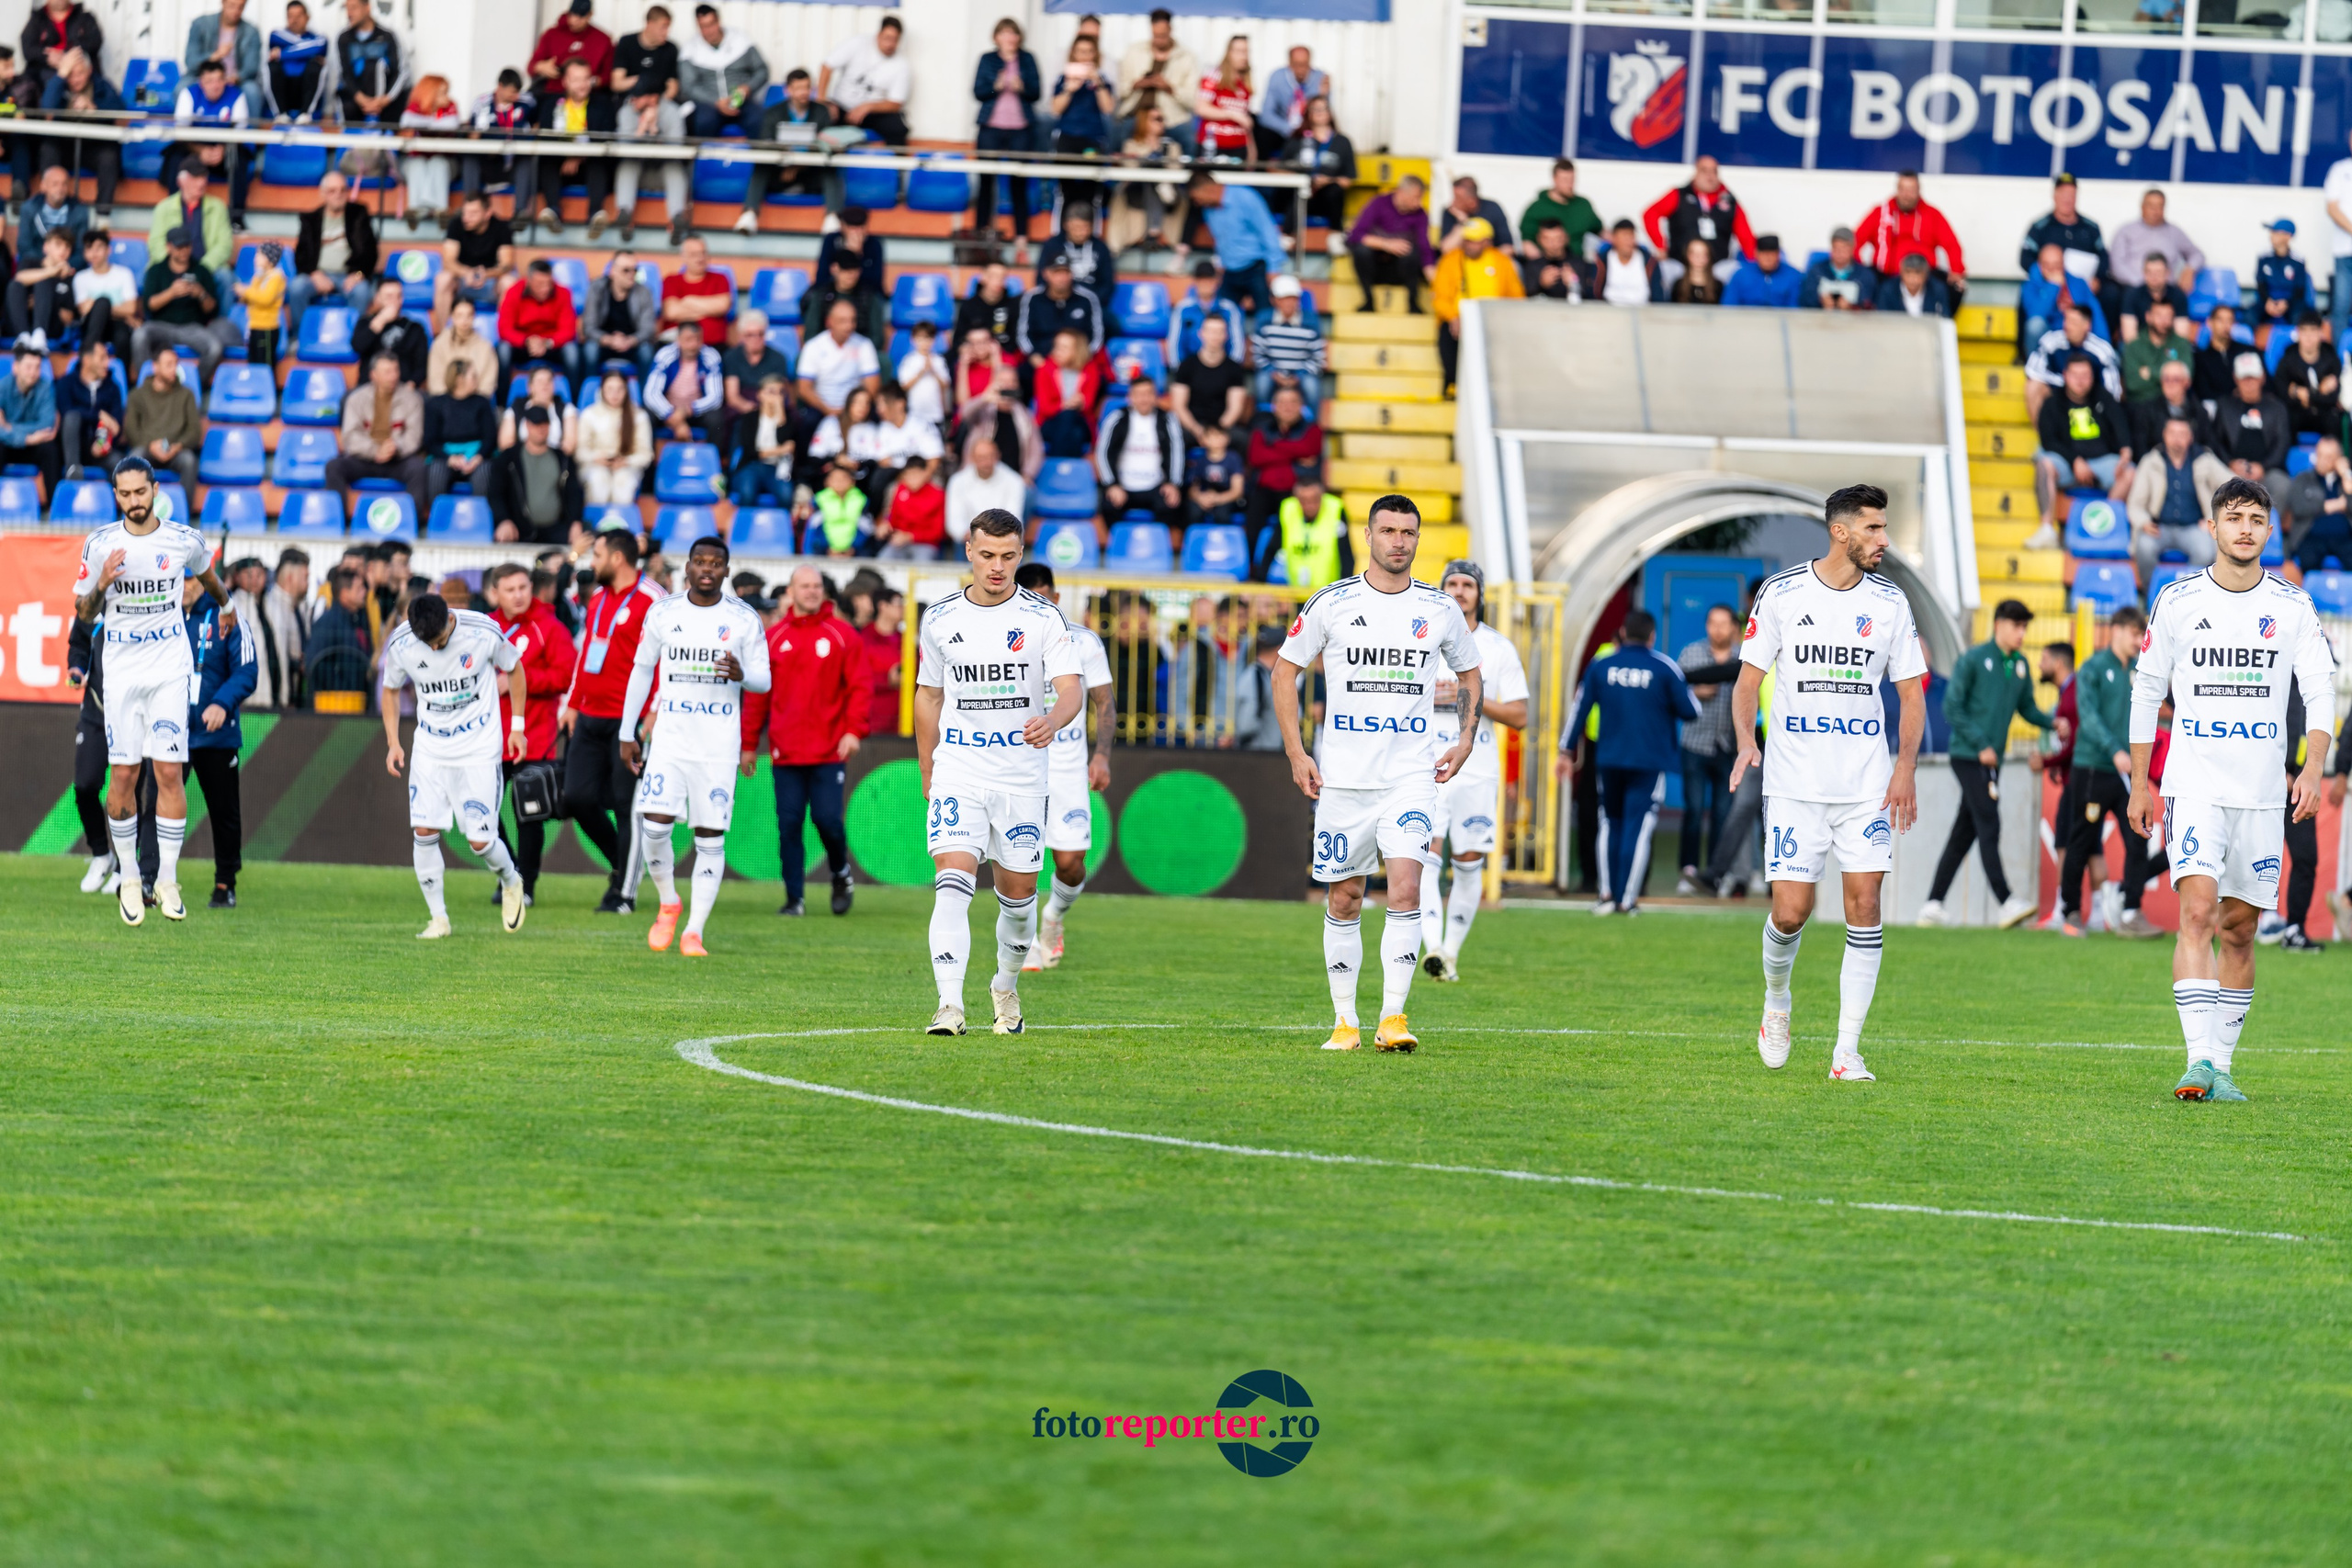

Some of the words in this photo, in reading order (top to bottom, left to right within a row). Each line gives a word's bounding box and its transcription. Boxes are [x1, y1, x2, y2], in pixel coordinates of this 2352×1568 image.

[1719, 64, 1824, 138] FC
[1850, 69, 2315, 166] BOTOȘANI
[114, 578, 177, 594] UNIBET
[107, 623, 182, 643] ELSACO
[1347, 647, 1430, 669] UNIBET
[1795, 644, 1875, 667] UNIBET
[2192, 648, 2278, 669] UNIBET
[953, 663, 1029, 682] UNIBET
[420, 673, 480, 694] UNIBET
[1390, 683, 1408, 694] SPRE
[1409, 685, 1420, 694] 0%
[1838, 684, 1856, 694] SPRE
[1857, 685, 1870, 694] 0%
[2239, 687, 2257, 696] SPRE
[2258, 688, 2267, 697] 0%
[994, 700, 1013, 709] SPRE
[1014, 699, 1025, 707] 0%
[1334, 714, 1427, 733] ELSACO
[1786, 716, 1881, 736] ELSACO
[2182, 718, 2278, 739] ELSACO
[945, 728, 1024, 748] ELSAC
[642, 773, 665, 795] 83
[931, 796, 959, 828] 33
[1317, 830, 1349, 863] 30
[1773, 826, 1798, 859] 16
[2181, 826, 2199, 856] 6
[1331, 865, 1355, 874] Vestra
[1786, 864, 1809, 874] Vestra
